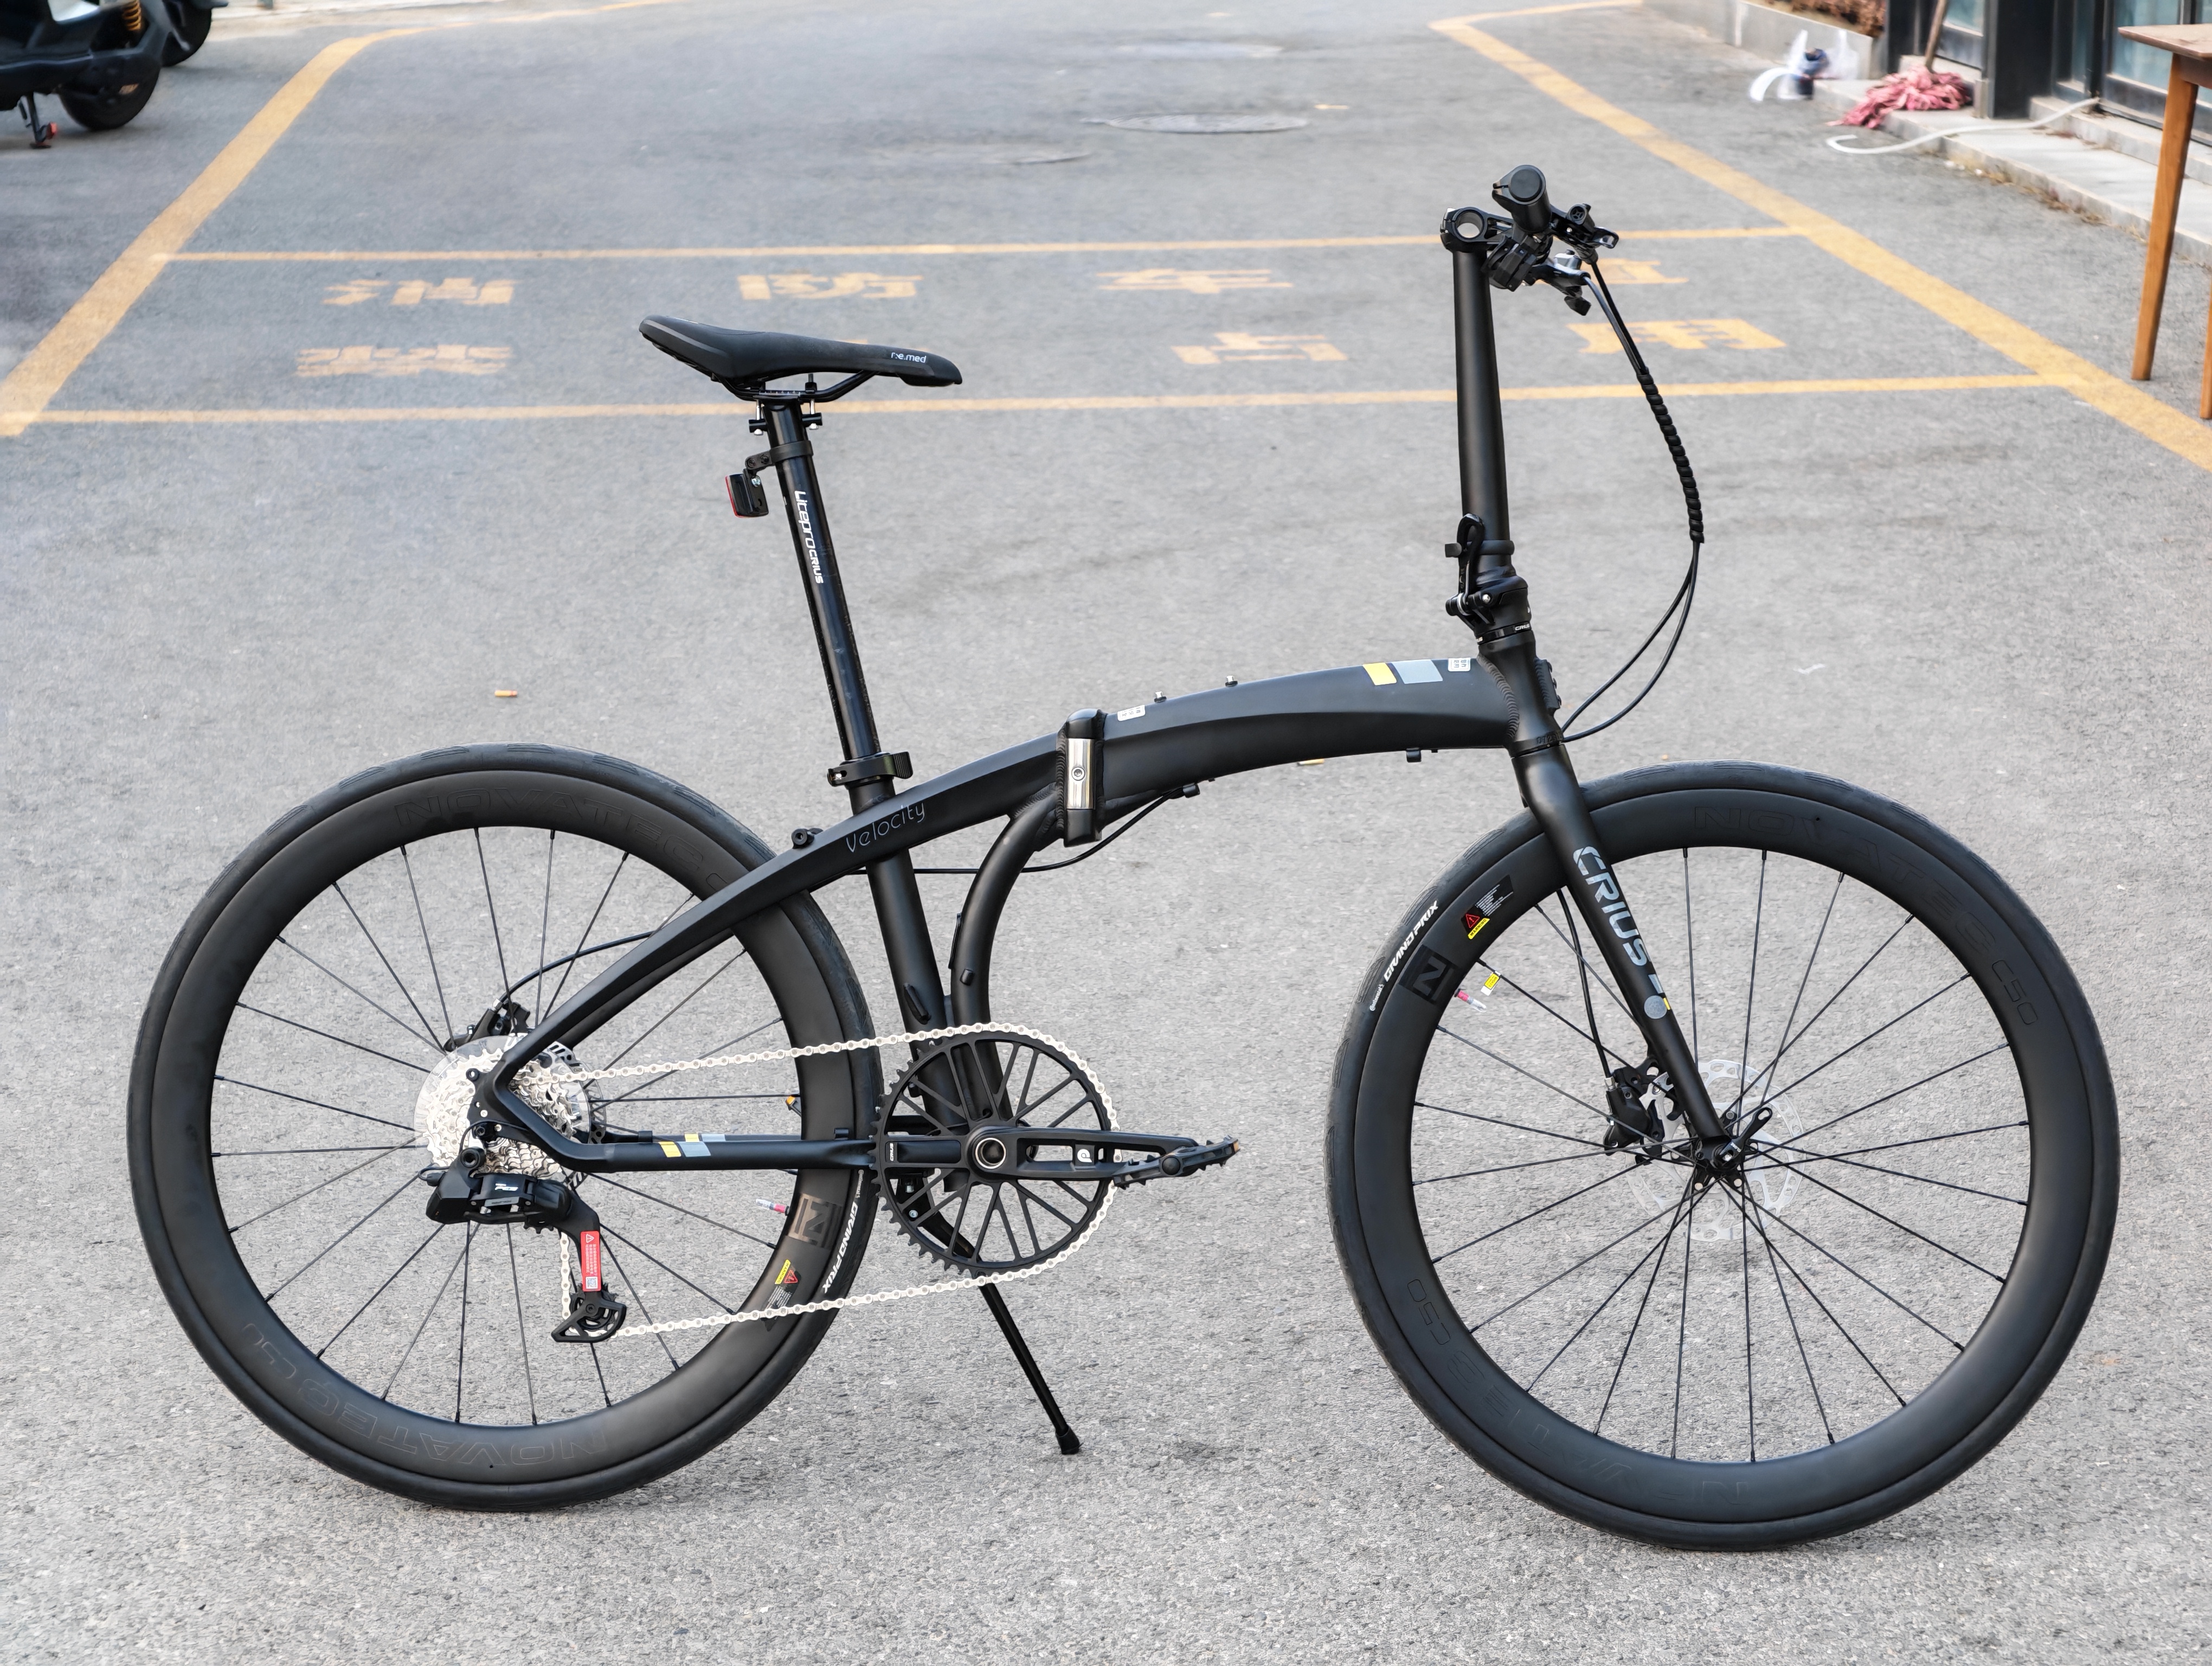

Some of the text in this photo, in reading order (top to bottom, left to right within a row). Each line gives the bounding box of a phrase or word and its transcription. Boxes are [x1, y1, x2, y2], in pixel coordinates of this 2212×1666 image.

[846, 801, 925, 853] Velocity
[1470, 919, 1487, 937] WARNING
[1573, 845, 1651, 967] CRIUS
[1991, 959, 2039, 1026] C50
[777, 1262, 790, 1284] WARNING
[1406, 1278, 1451, 1346] C50
